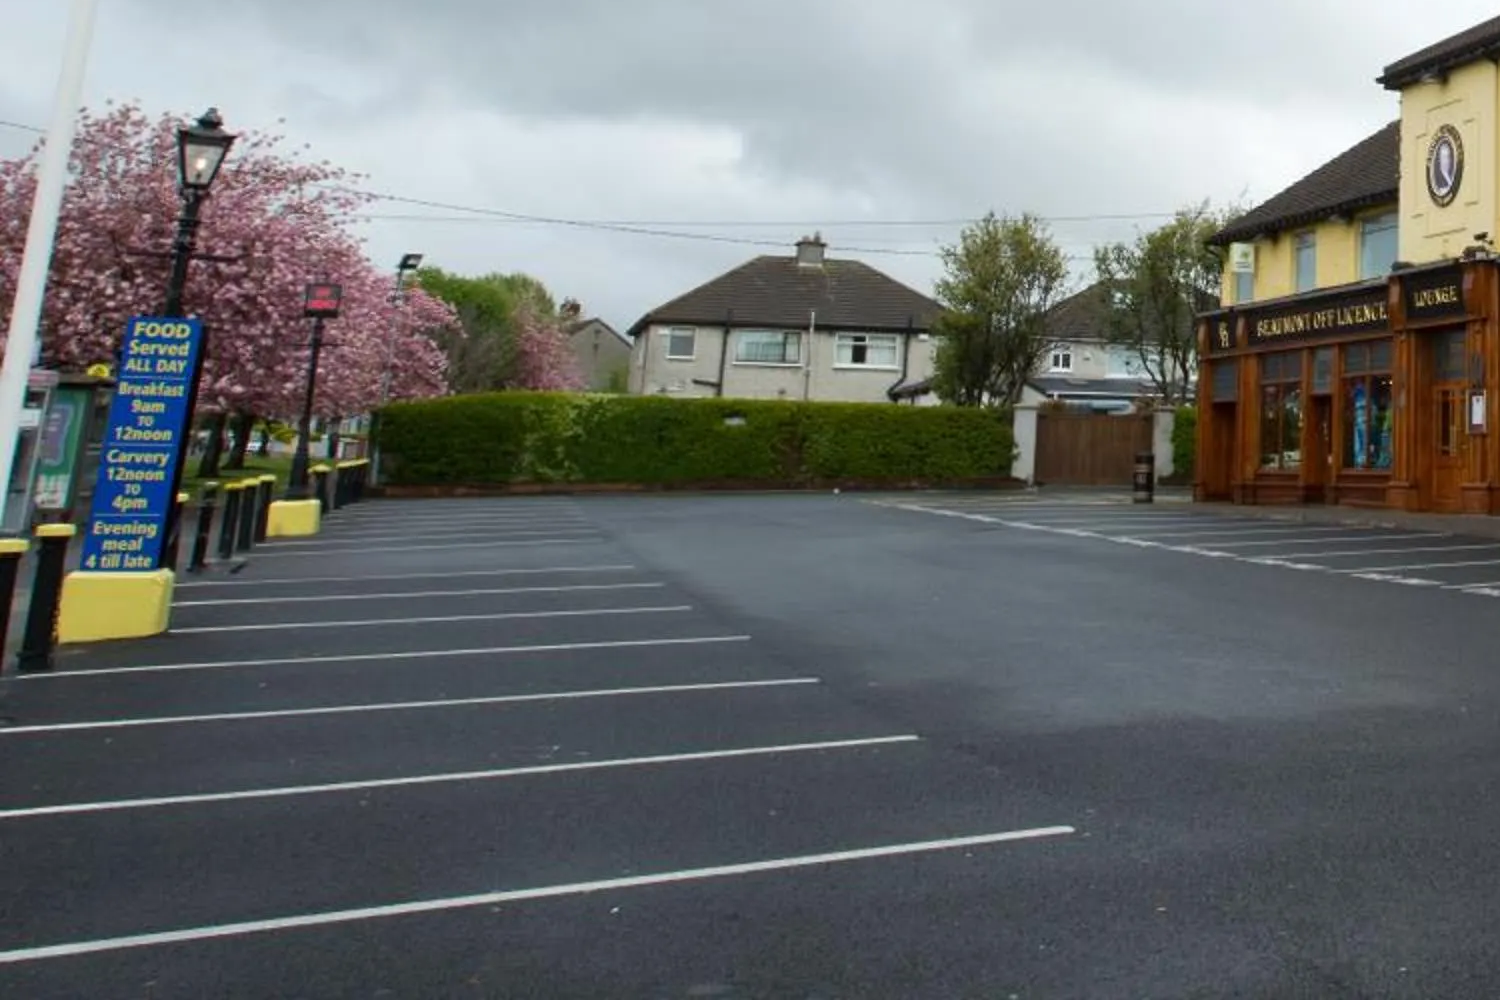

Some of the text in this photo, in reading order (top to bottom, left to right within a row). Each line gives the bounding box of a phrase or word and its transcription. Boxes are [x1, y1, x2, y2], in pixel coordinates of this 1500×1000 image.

[1413, 285, 1457, 307] LOUNGE
[1257, 313, 1311, 337] BEAUMONT
[1313, 309, 1335, 329] OFF
[1337, 301, 1388, 326] LICENCE
[133, 321, 191, 338] FOOD
[129, 340, 190, 357] Served
[124, 358, 187, 373] ALL DAY
[118, 381, 184, 397] Breakfast
[131, 400, 165, 413] 9am
[137, 415, 154, 426] TO
[115, 427, 173, 441] 12noon
[106, 449, 170, 467] Carvery
[106, 467, 165, 481] 12noon
[124, 484, 141, 495] TO
[112, 495, 148, 512] 4pm
[93, 521, 158, 538] Evening
[102, 537, 143, 551] meal
[84, 554, 152, 568] 4 till late
